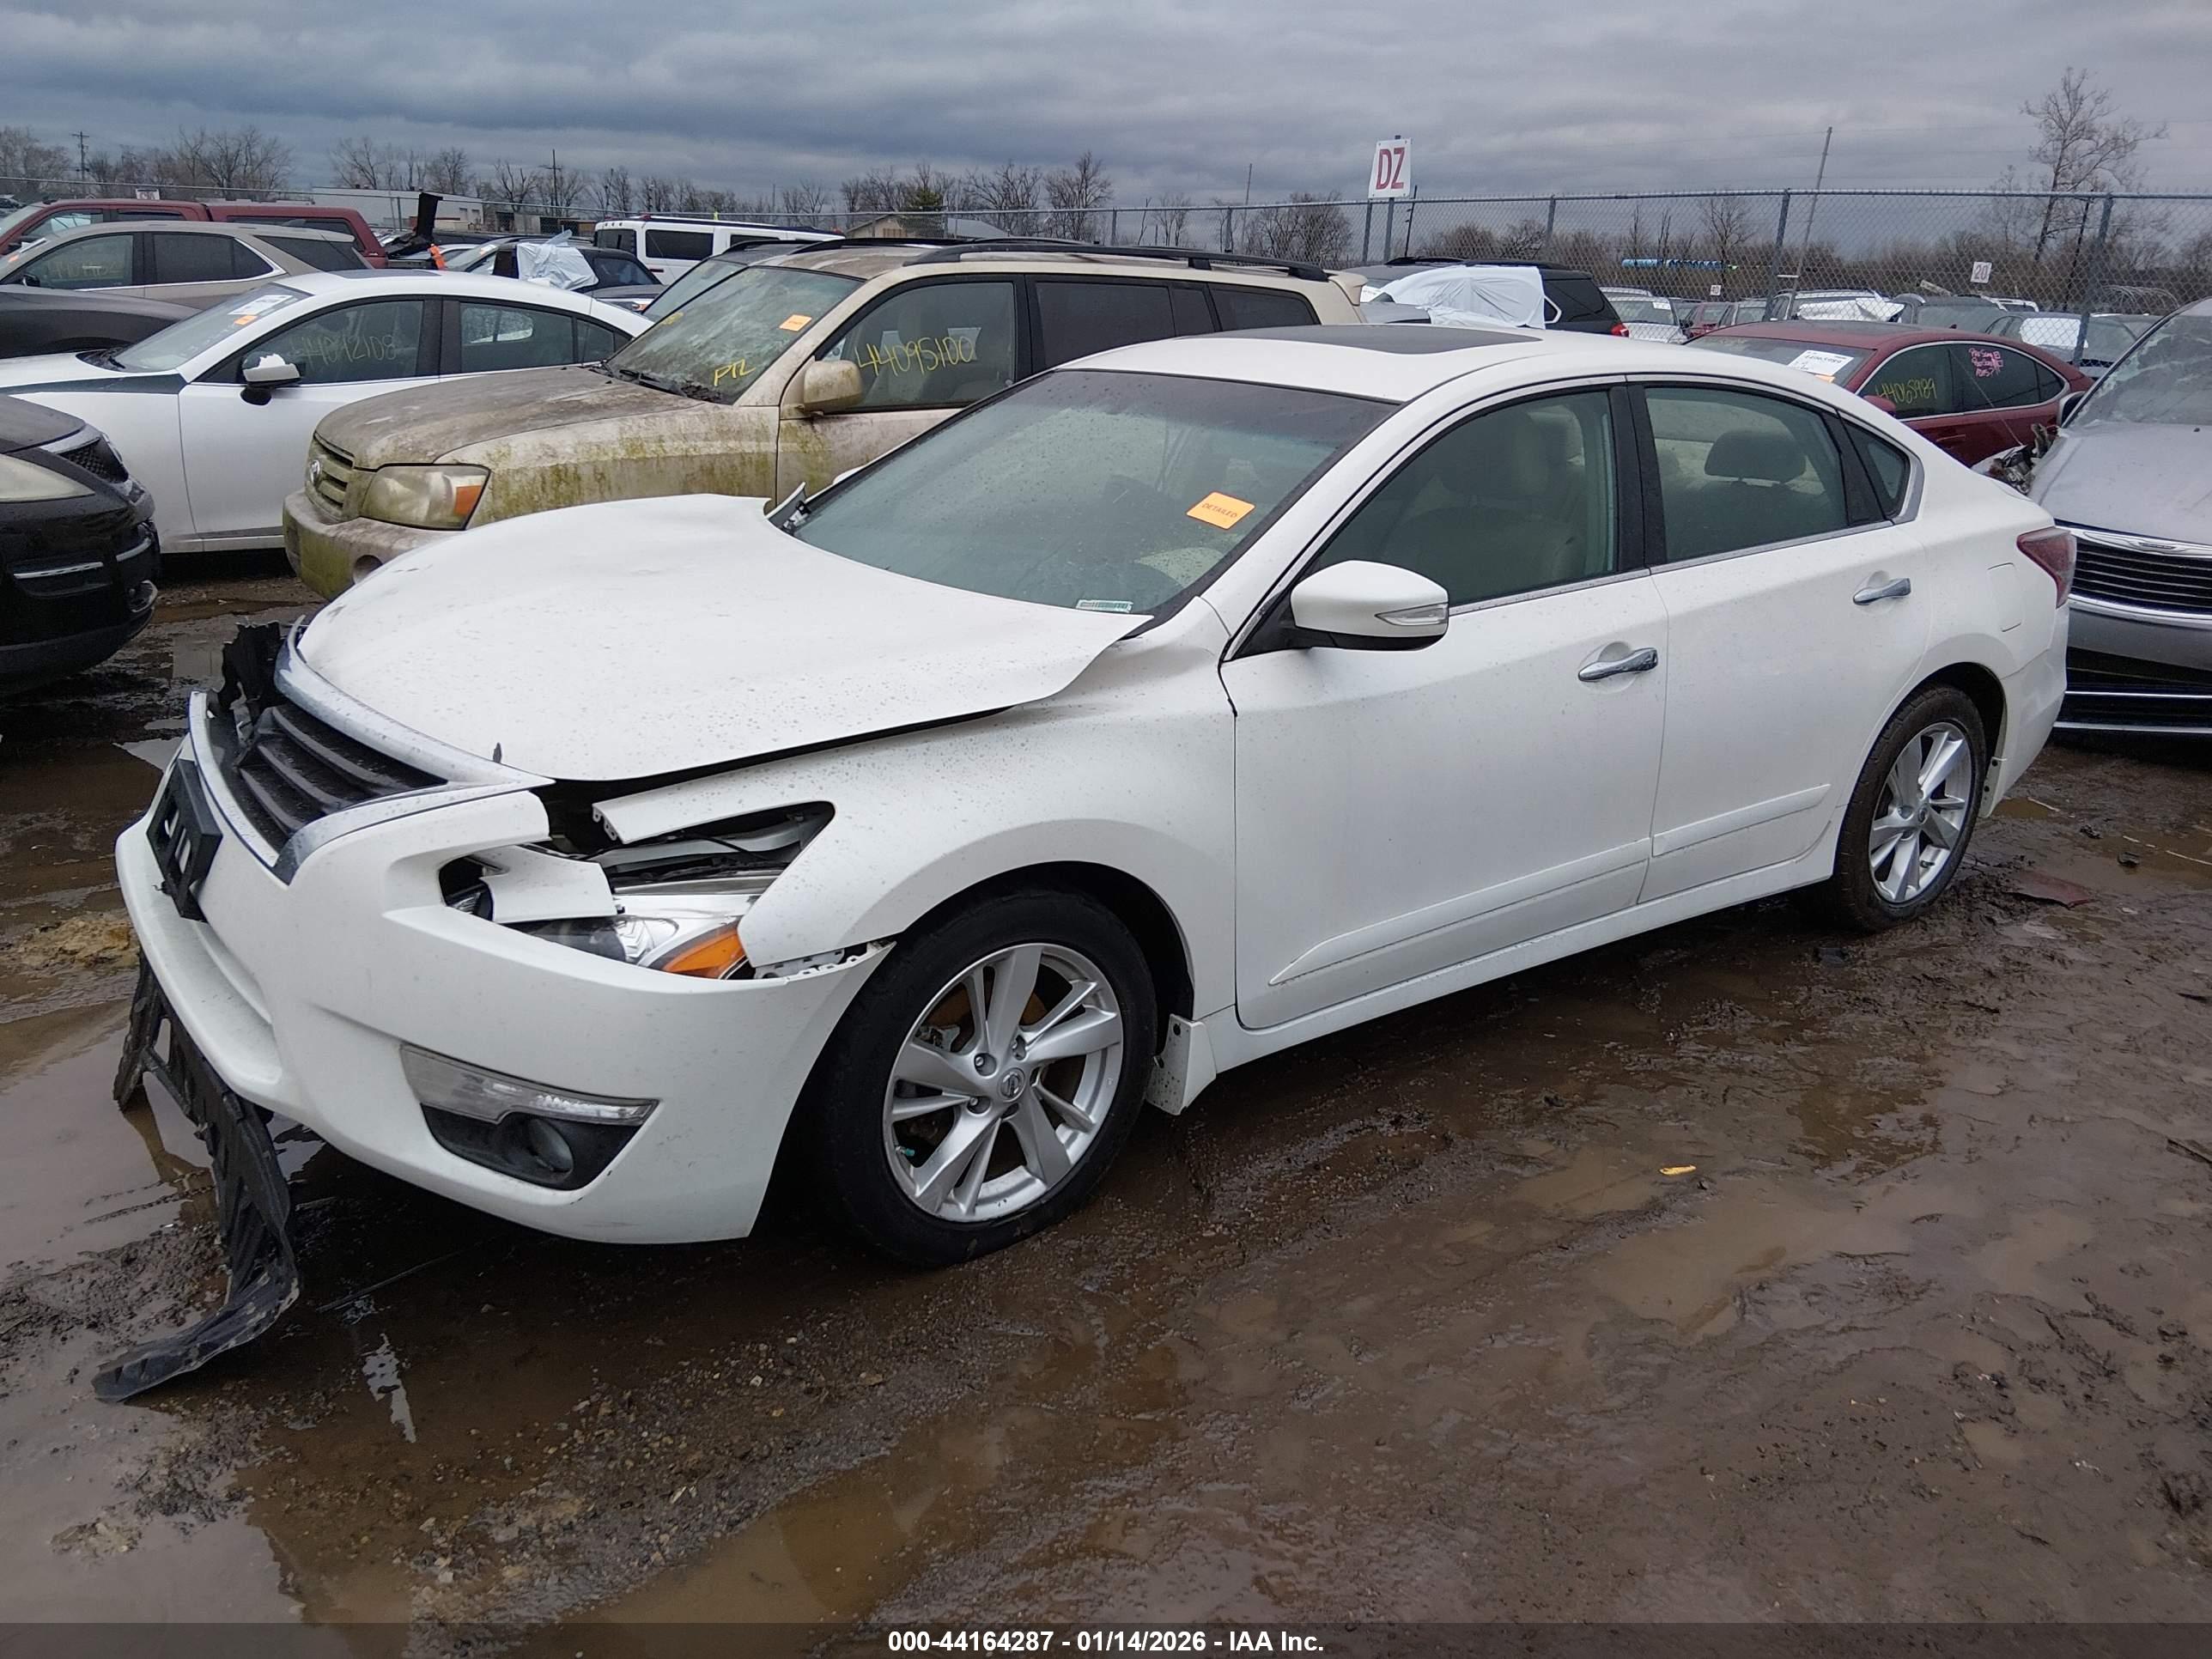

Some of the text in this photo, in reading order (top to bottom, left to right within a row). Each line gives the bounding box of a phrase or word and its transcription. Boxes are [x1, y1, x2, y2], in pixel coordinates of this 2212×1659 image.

[1376, 147, 1405, 190] DZ
[1974, 264, 1989, 281] 20
[1711, 286, 1719, 295] 40
[854, 336, 974, 377] 44095100
